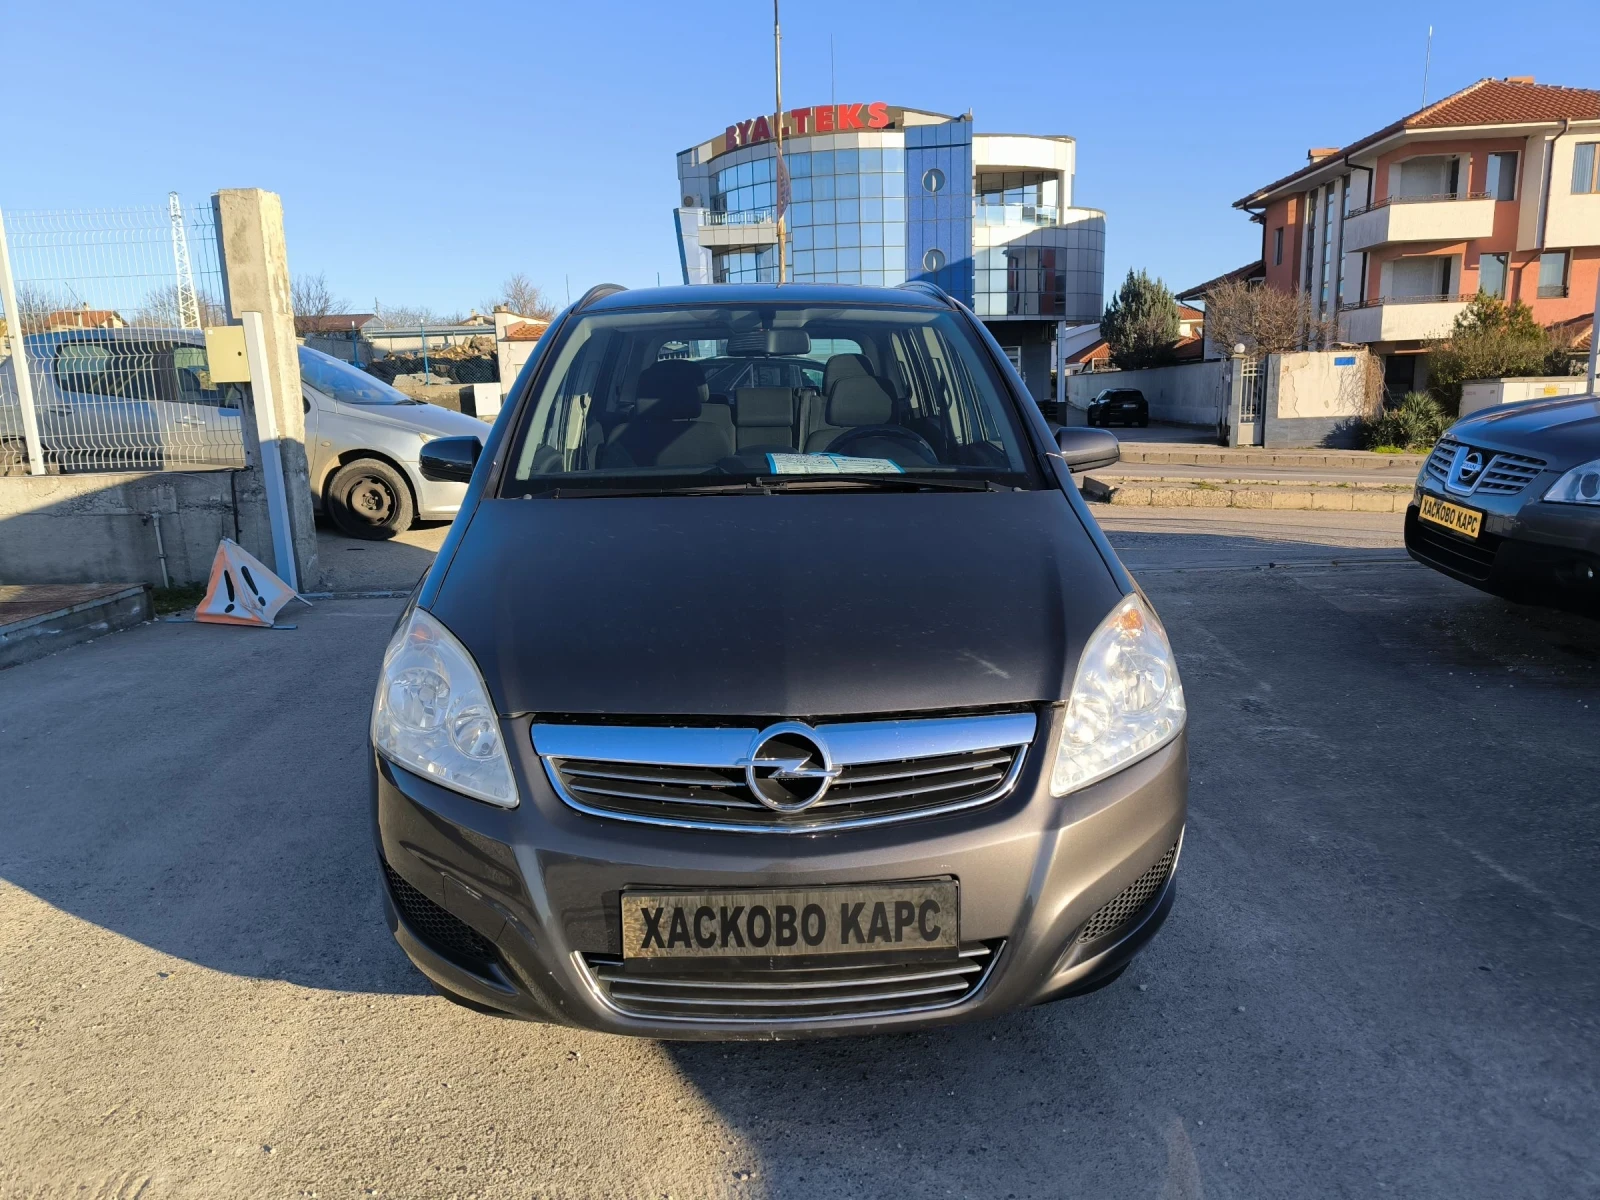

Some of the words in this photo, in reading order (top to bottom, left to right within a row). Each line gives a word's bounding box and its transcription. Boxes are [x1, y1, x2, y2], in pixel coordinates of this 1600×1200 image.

[725, 101, 890, 151] BYALTEKS
[1422, 499, 1456, 525] ХАСКОВО
[1456, 511, 1478, 533] КАРС
[640, 903, 827, 949] ХАСКОВО
[840, 899, 942, 945] КАРС
